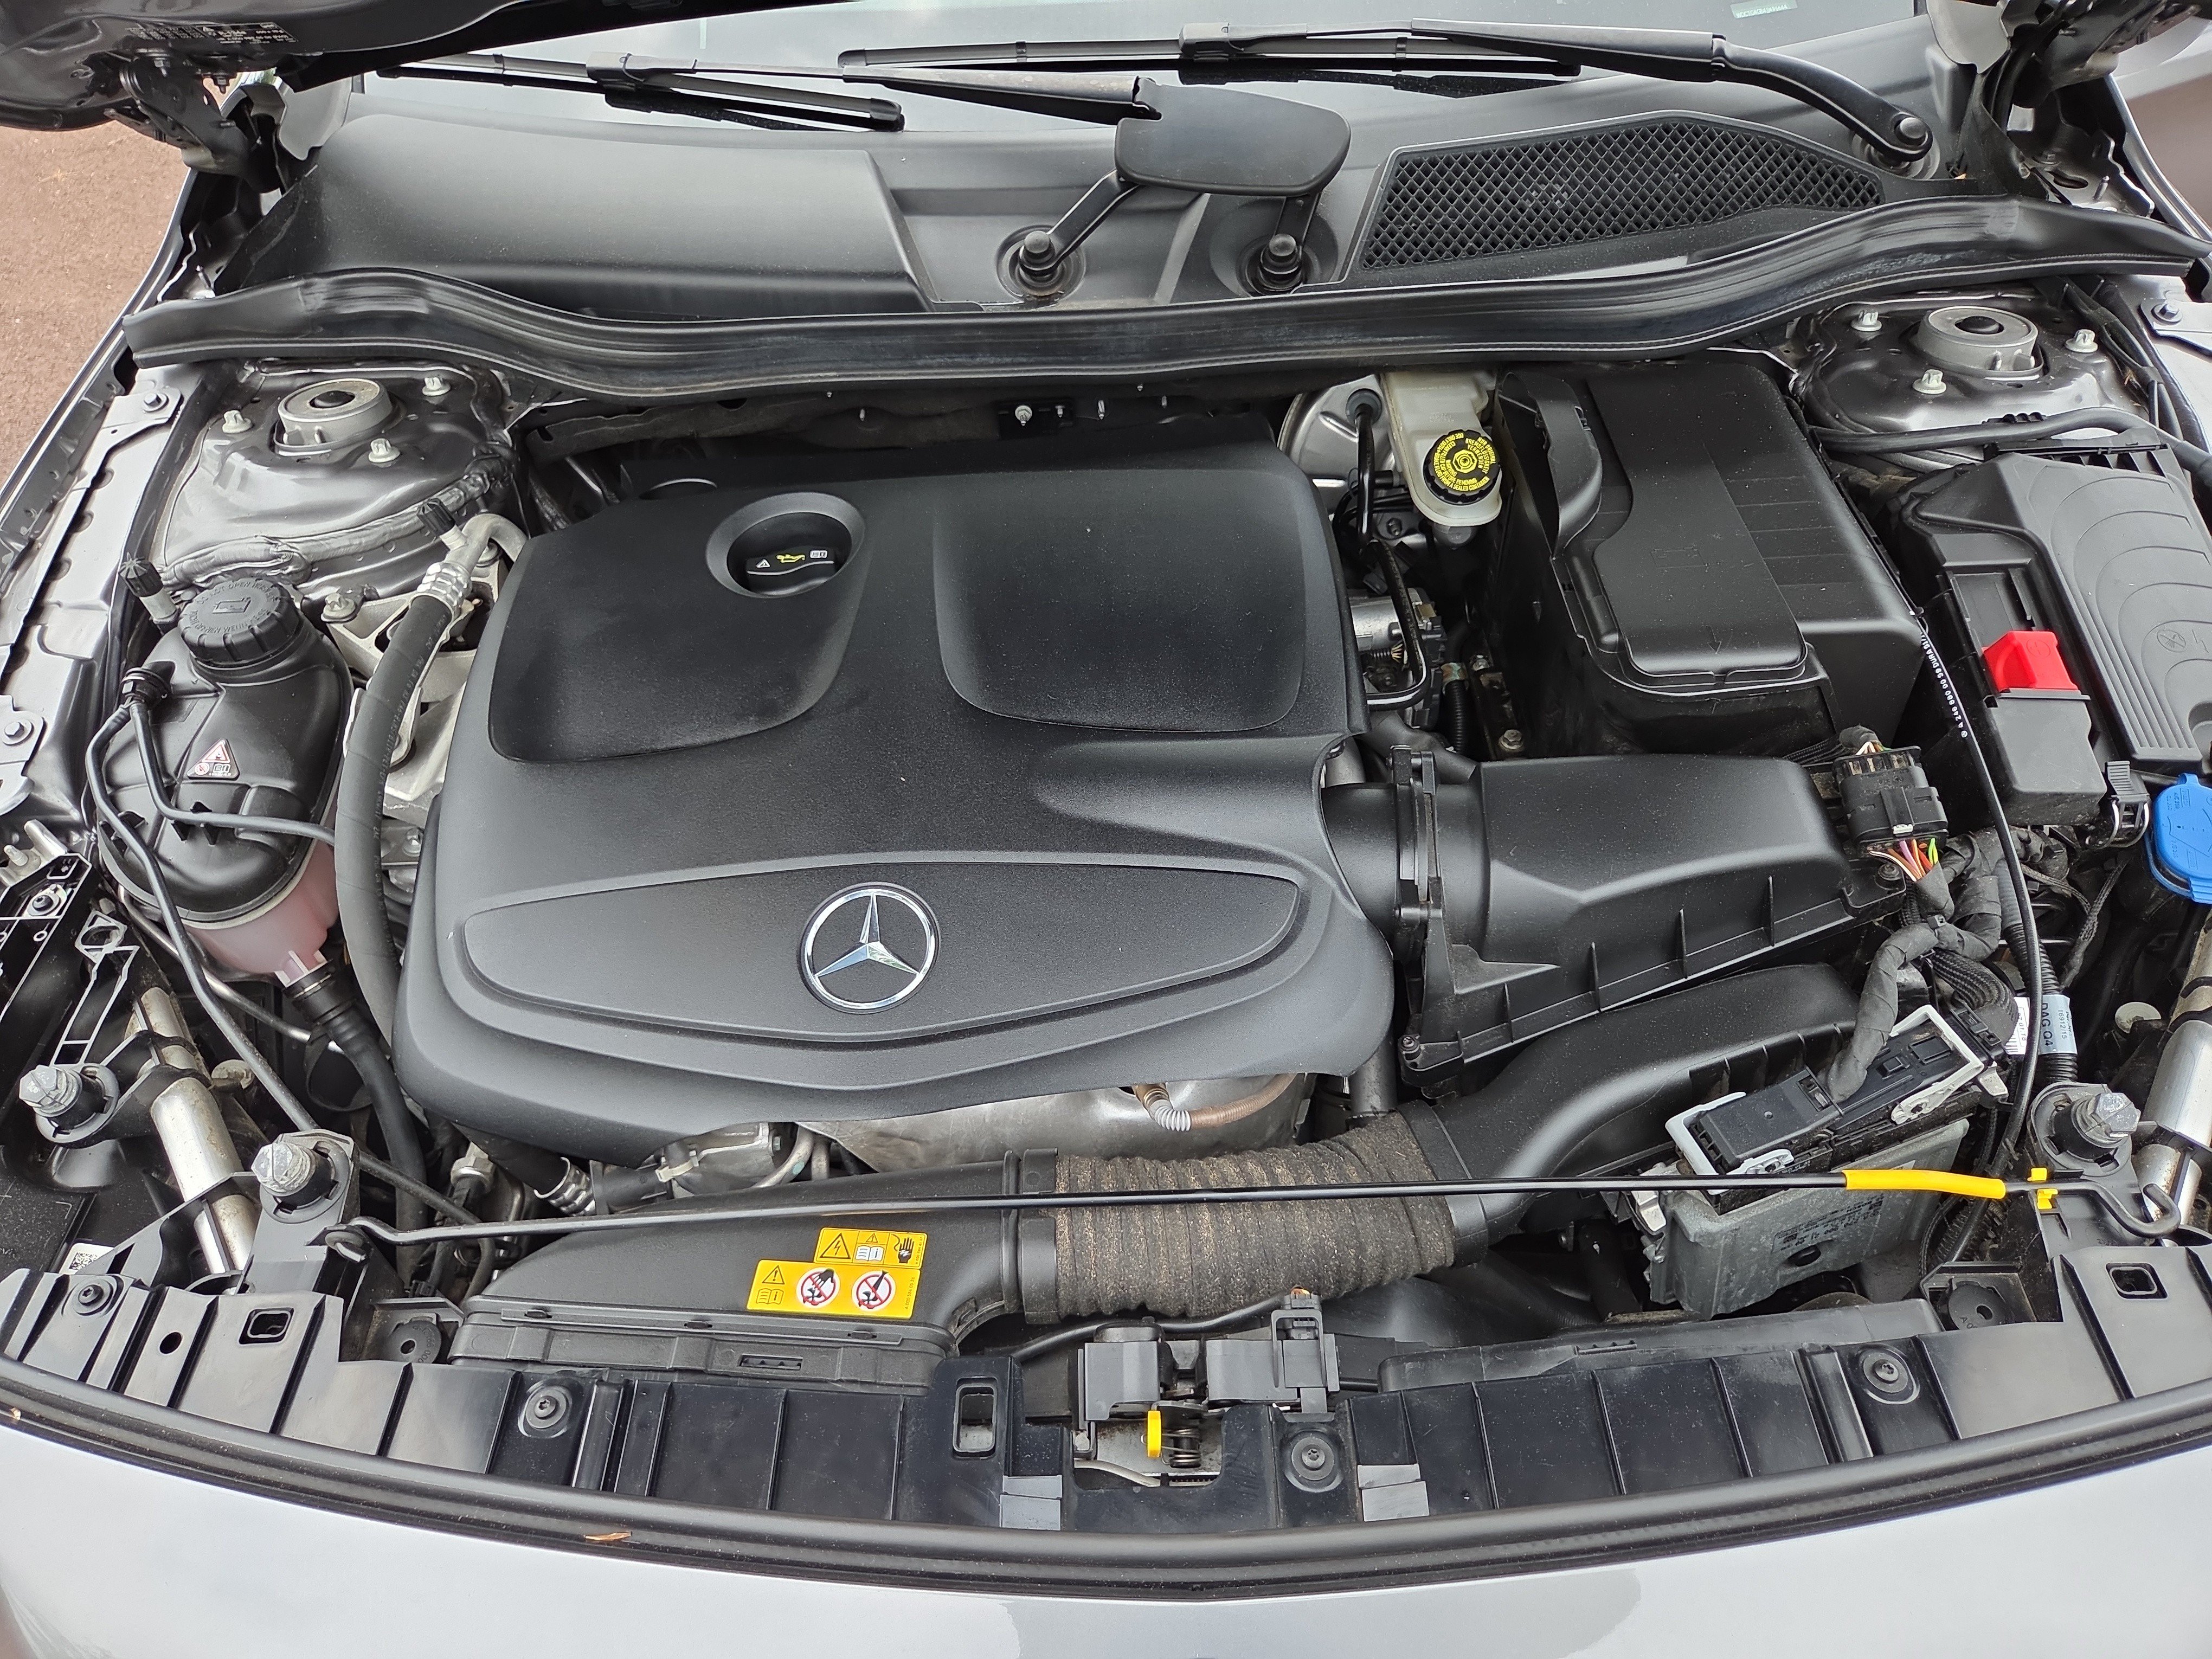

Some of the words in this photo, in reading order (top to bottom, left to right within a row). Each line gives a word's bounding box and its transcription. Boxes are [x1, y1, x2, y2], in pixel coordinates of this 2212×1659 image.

[1477, 436, 1487, 445] NUR
[1485, 444, 1496, 465] ORIGINAL
[1439, 475, 1450, 486] FROM
[1443, 470, 1456, 483] BEFORE
[1926, 649, 1939, 668] DURA
[1940, 679, 1949, 689] 00
[1952, 706, 1962, 721] 246
[2057, 1009, 2067, 1039] 16912/15
